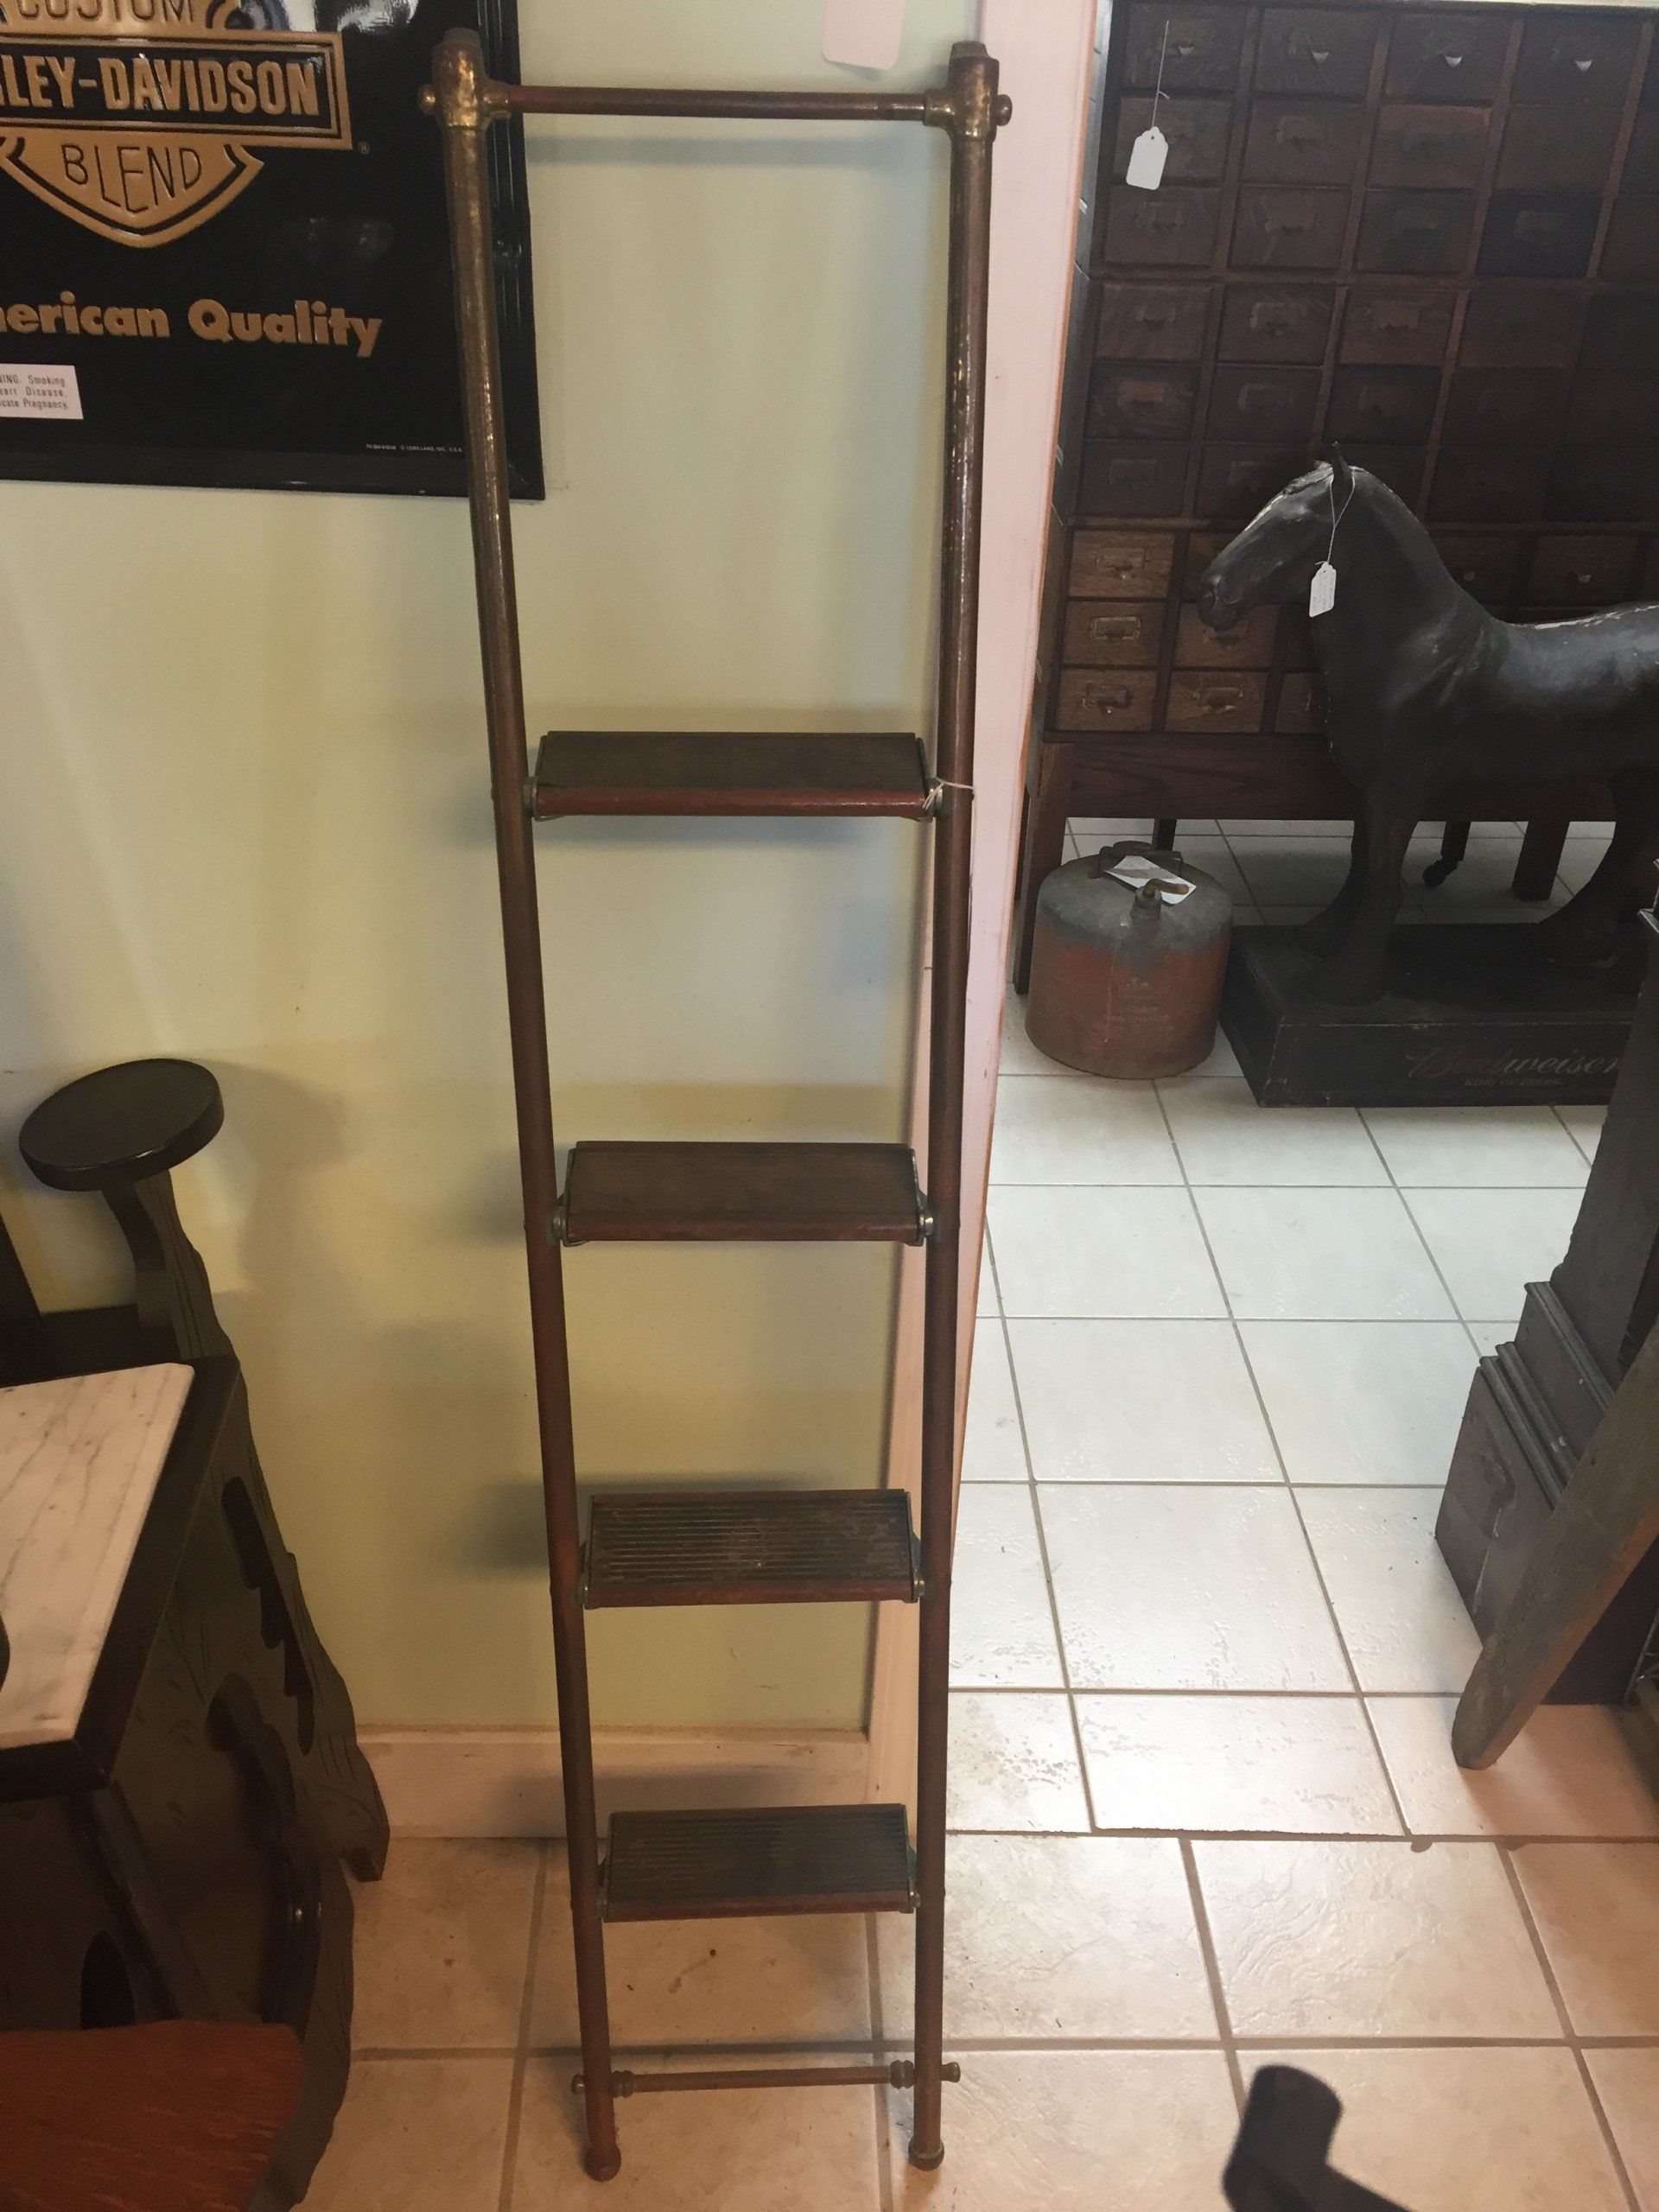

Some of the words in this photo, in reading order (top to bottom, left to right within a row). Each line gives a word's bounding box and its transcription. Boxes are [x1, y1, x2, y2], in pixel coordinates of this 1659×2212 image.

[0, 54, 319, 116] LEY-DAVIDSON
[61, 143, 202, 213] BLEND
[0, 290, 170, 338] erican
[188, 298, 383, 358] Quality
[28, 374, 66, 387] Smoking
